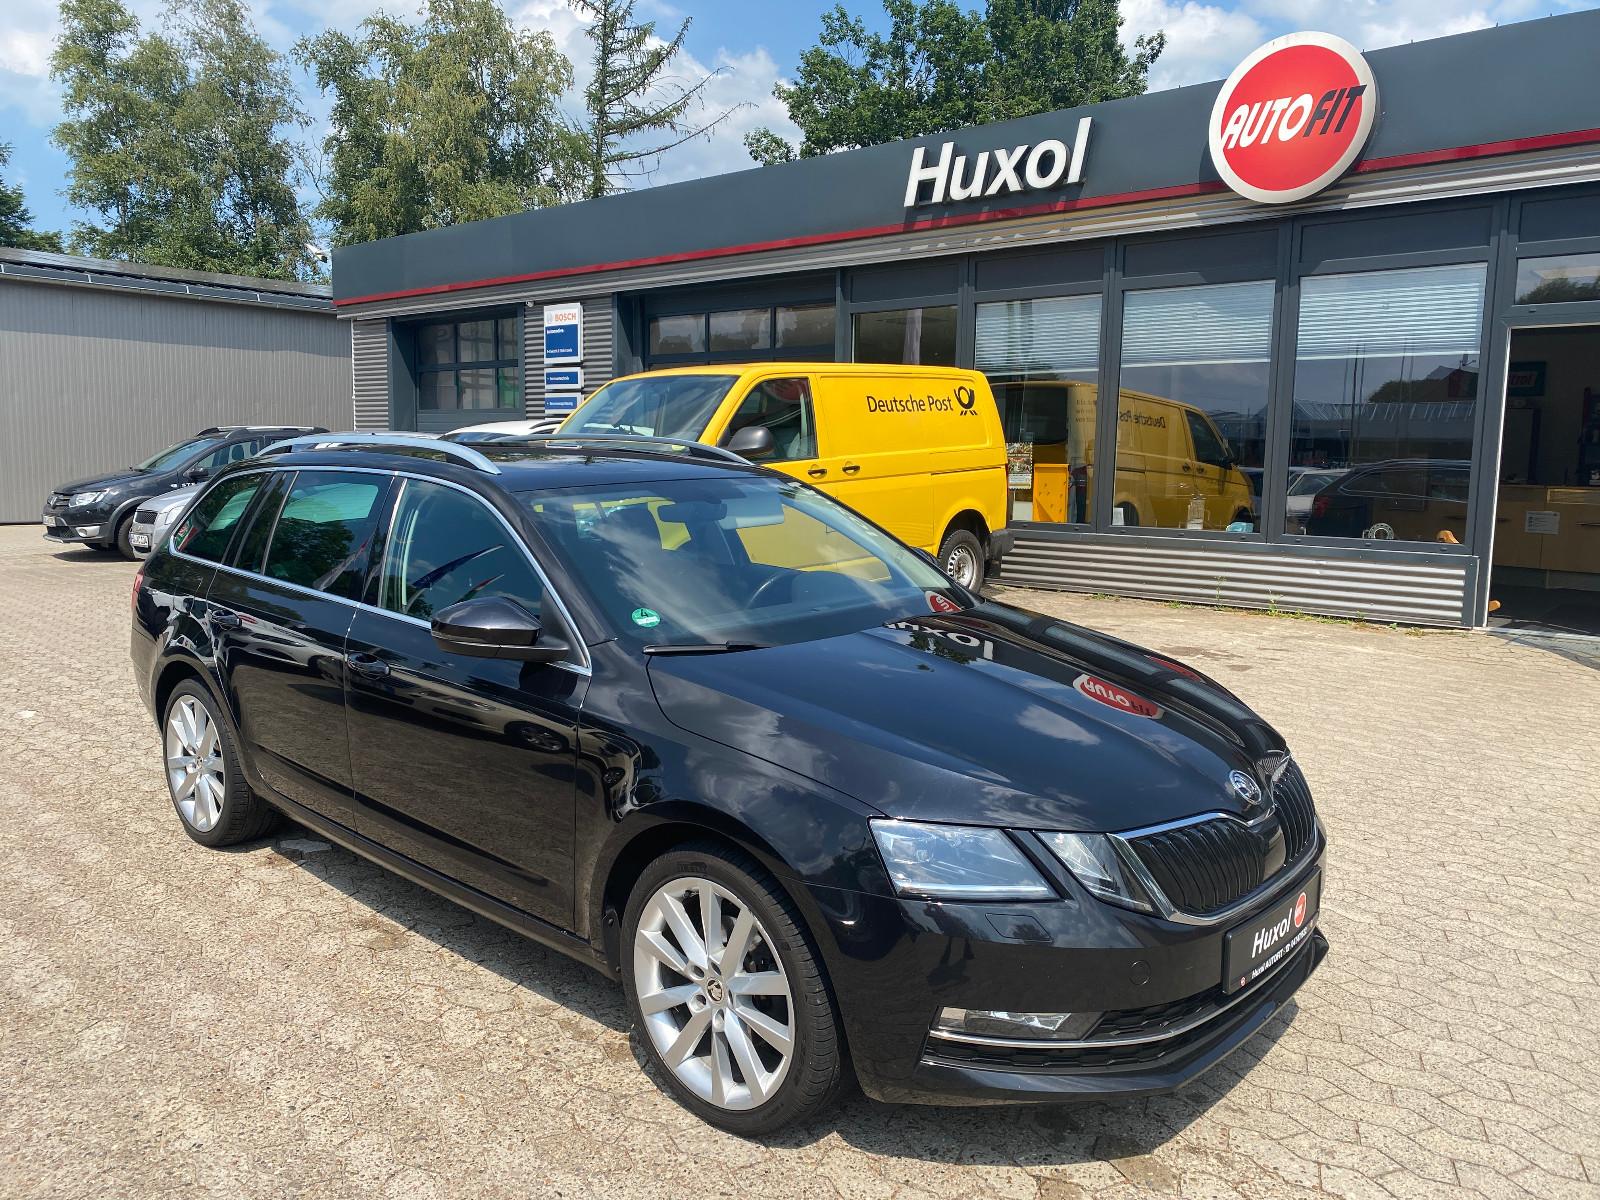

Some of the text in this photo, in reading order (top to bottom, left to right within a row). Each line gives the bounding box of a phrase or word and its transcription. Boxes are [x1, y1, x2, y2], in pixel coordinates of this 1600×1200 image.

[1221, 84, 1368, 150] AUTOFIT
[904, 117, 1091, 207] Huxol
[554, 312, 577, 322] BOSCH
[866, 393, 955, 413] Deutsche Post
[1252, 908, 1292, 958] Huxol
